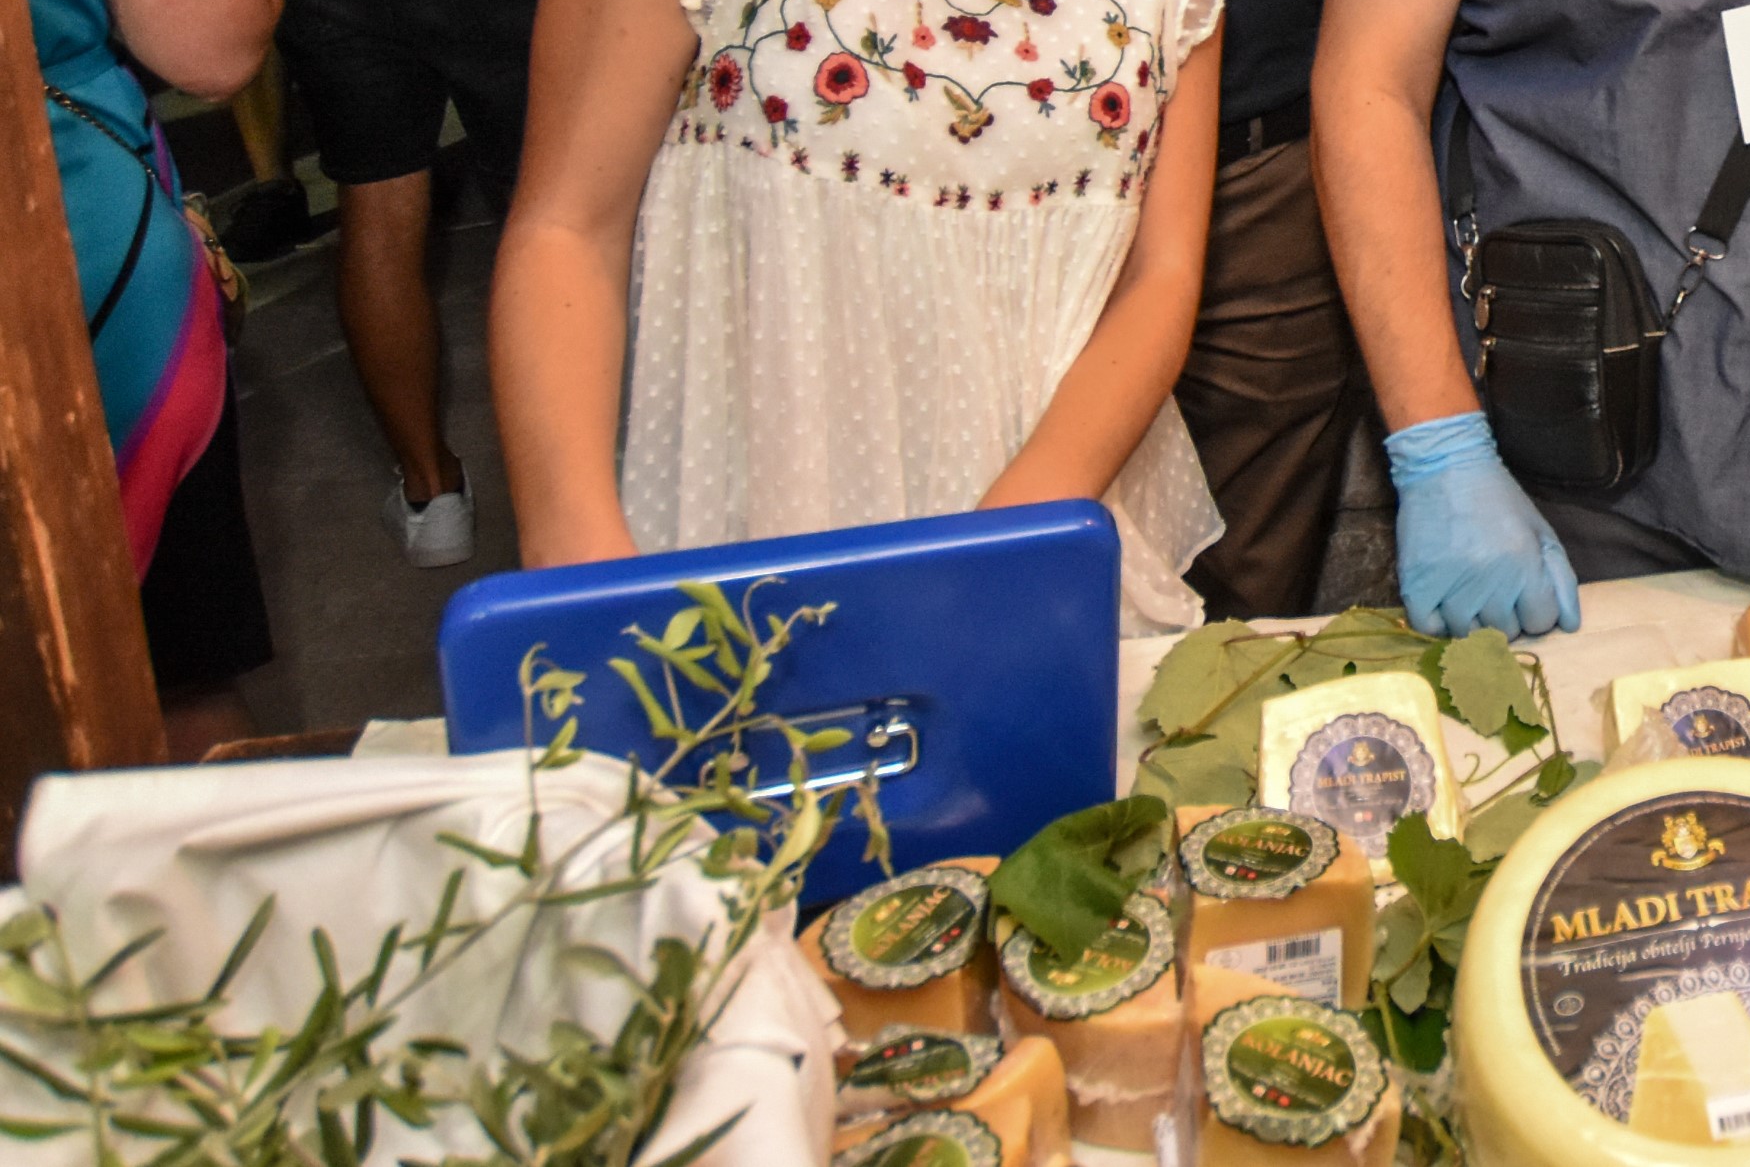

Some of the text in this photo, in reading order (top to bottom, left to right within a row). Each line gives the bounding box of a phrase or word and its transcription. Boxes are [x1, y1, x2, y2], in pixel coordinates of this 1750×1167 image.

[1358, 770, 1406, 784] TRAPIST
[1551, 891, 1683, 944] MLADI
[1559, 947, 1637, 977] Tradicija
[1641, 937, 1697, 964] obitelji
[1241, 1034, 1352, 1088] KOLANJAC
